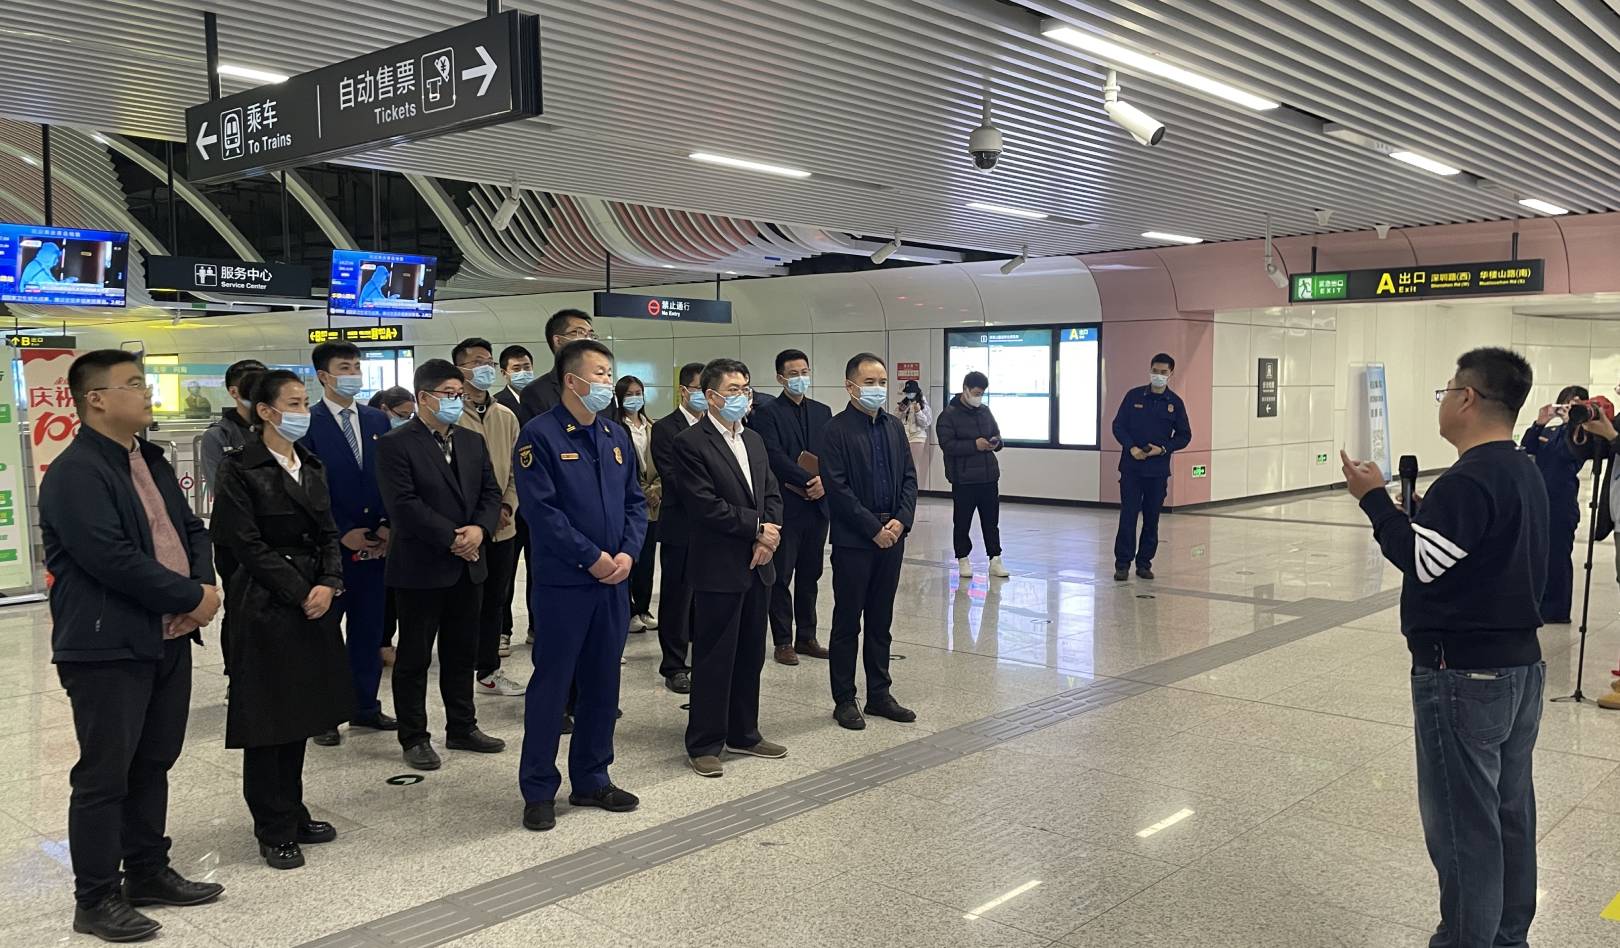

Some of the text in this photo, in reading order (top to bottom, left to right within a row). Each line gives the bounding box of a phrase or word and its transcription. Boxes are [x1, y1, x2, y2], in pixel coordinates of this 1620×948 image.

[339, 59, 416, 110] 自动售票
[247, 99, 278, 133] 乘车
[374, 102, 417, 125] Tickets
[248, 133, 292, 155] To Trains
[221, 266, 273, 282] 服务中心
[1399, 272, 1426, 284] 出口
[221, 281, 267, 290] Service Center
[1376, 273, 1396, 295] A
[661, 300, 690, 311] 禁止通行
[21, 336, 31, 346] B
[1069, 329, 1079, 340] A
